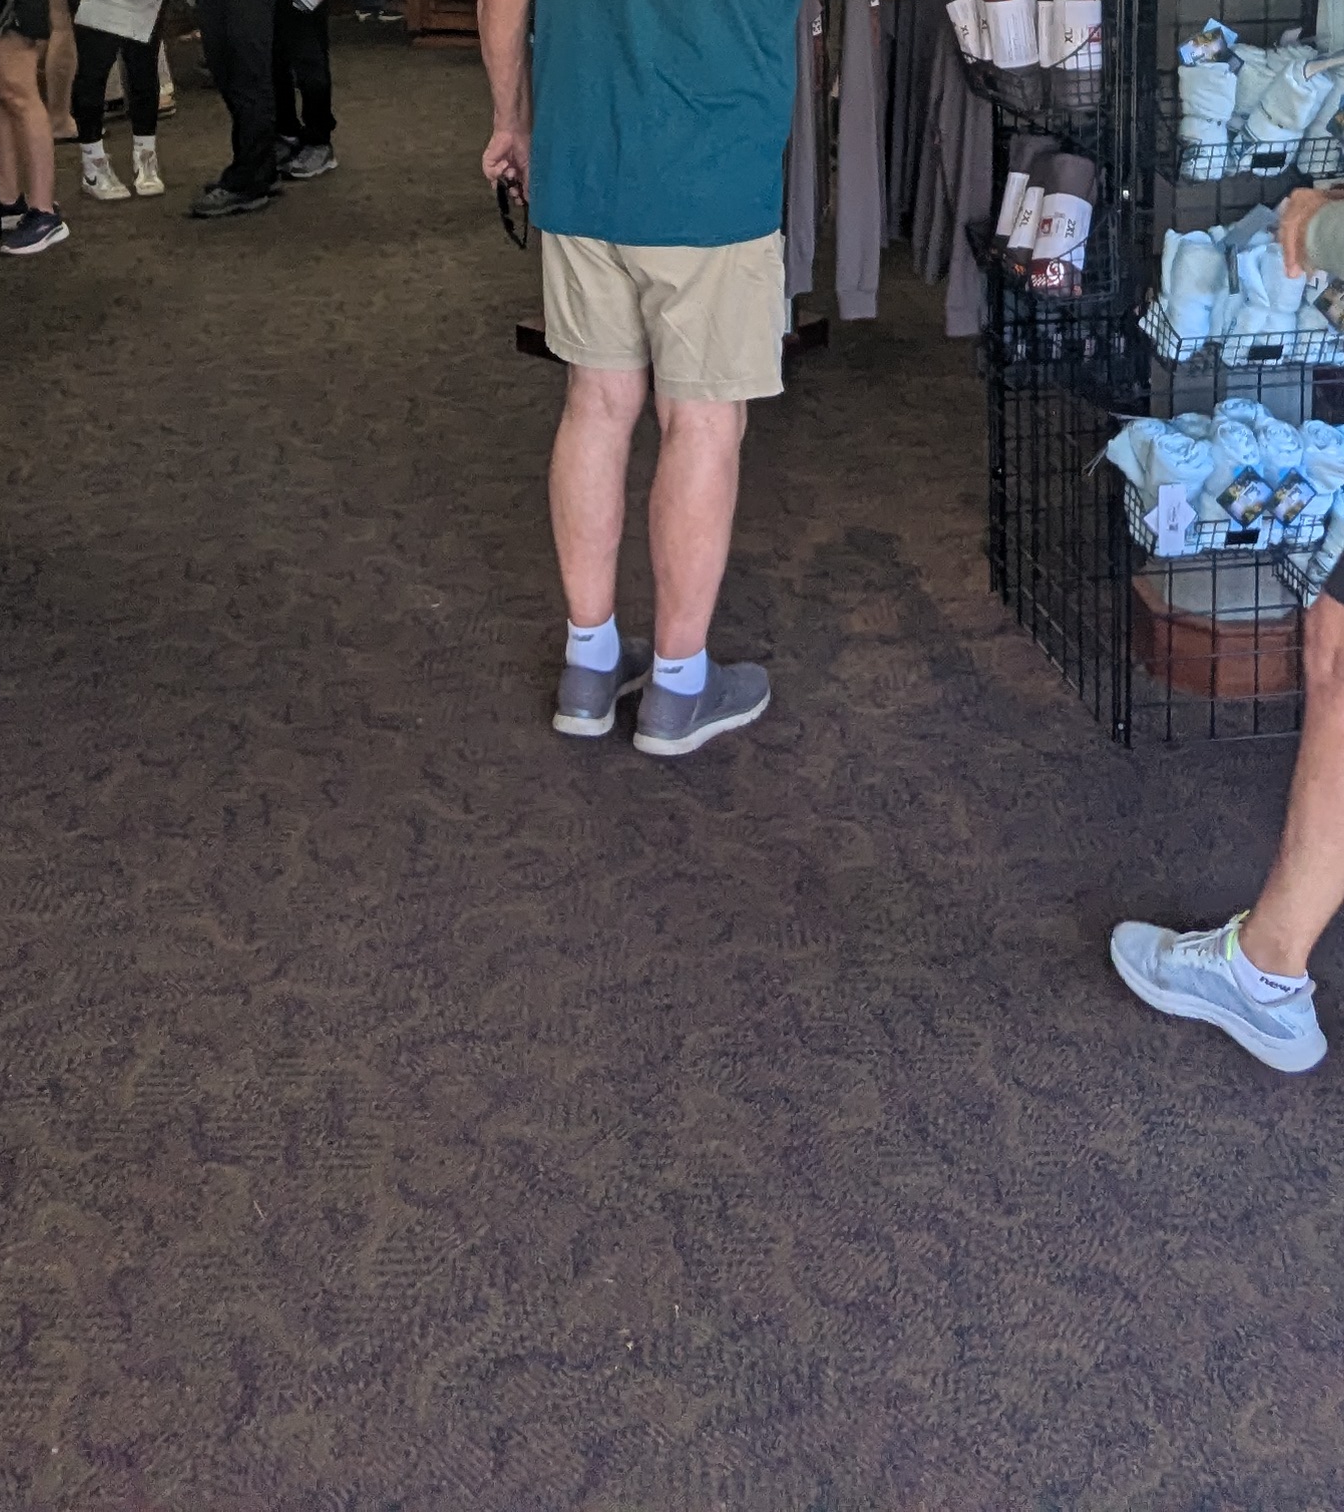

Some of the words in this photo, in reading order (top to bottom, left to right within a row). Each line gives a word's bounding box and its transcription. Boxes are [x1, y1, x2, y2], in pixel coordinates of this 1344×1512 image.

[959, 24, 970, 39] XL
[1064, 29, 1073, 43] XL
[1019, 209, 1033, 227] 2XL
[1064, 218, 1077, 238] 2XL
[1259, 976, 1291, 993] new
